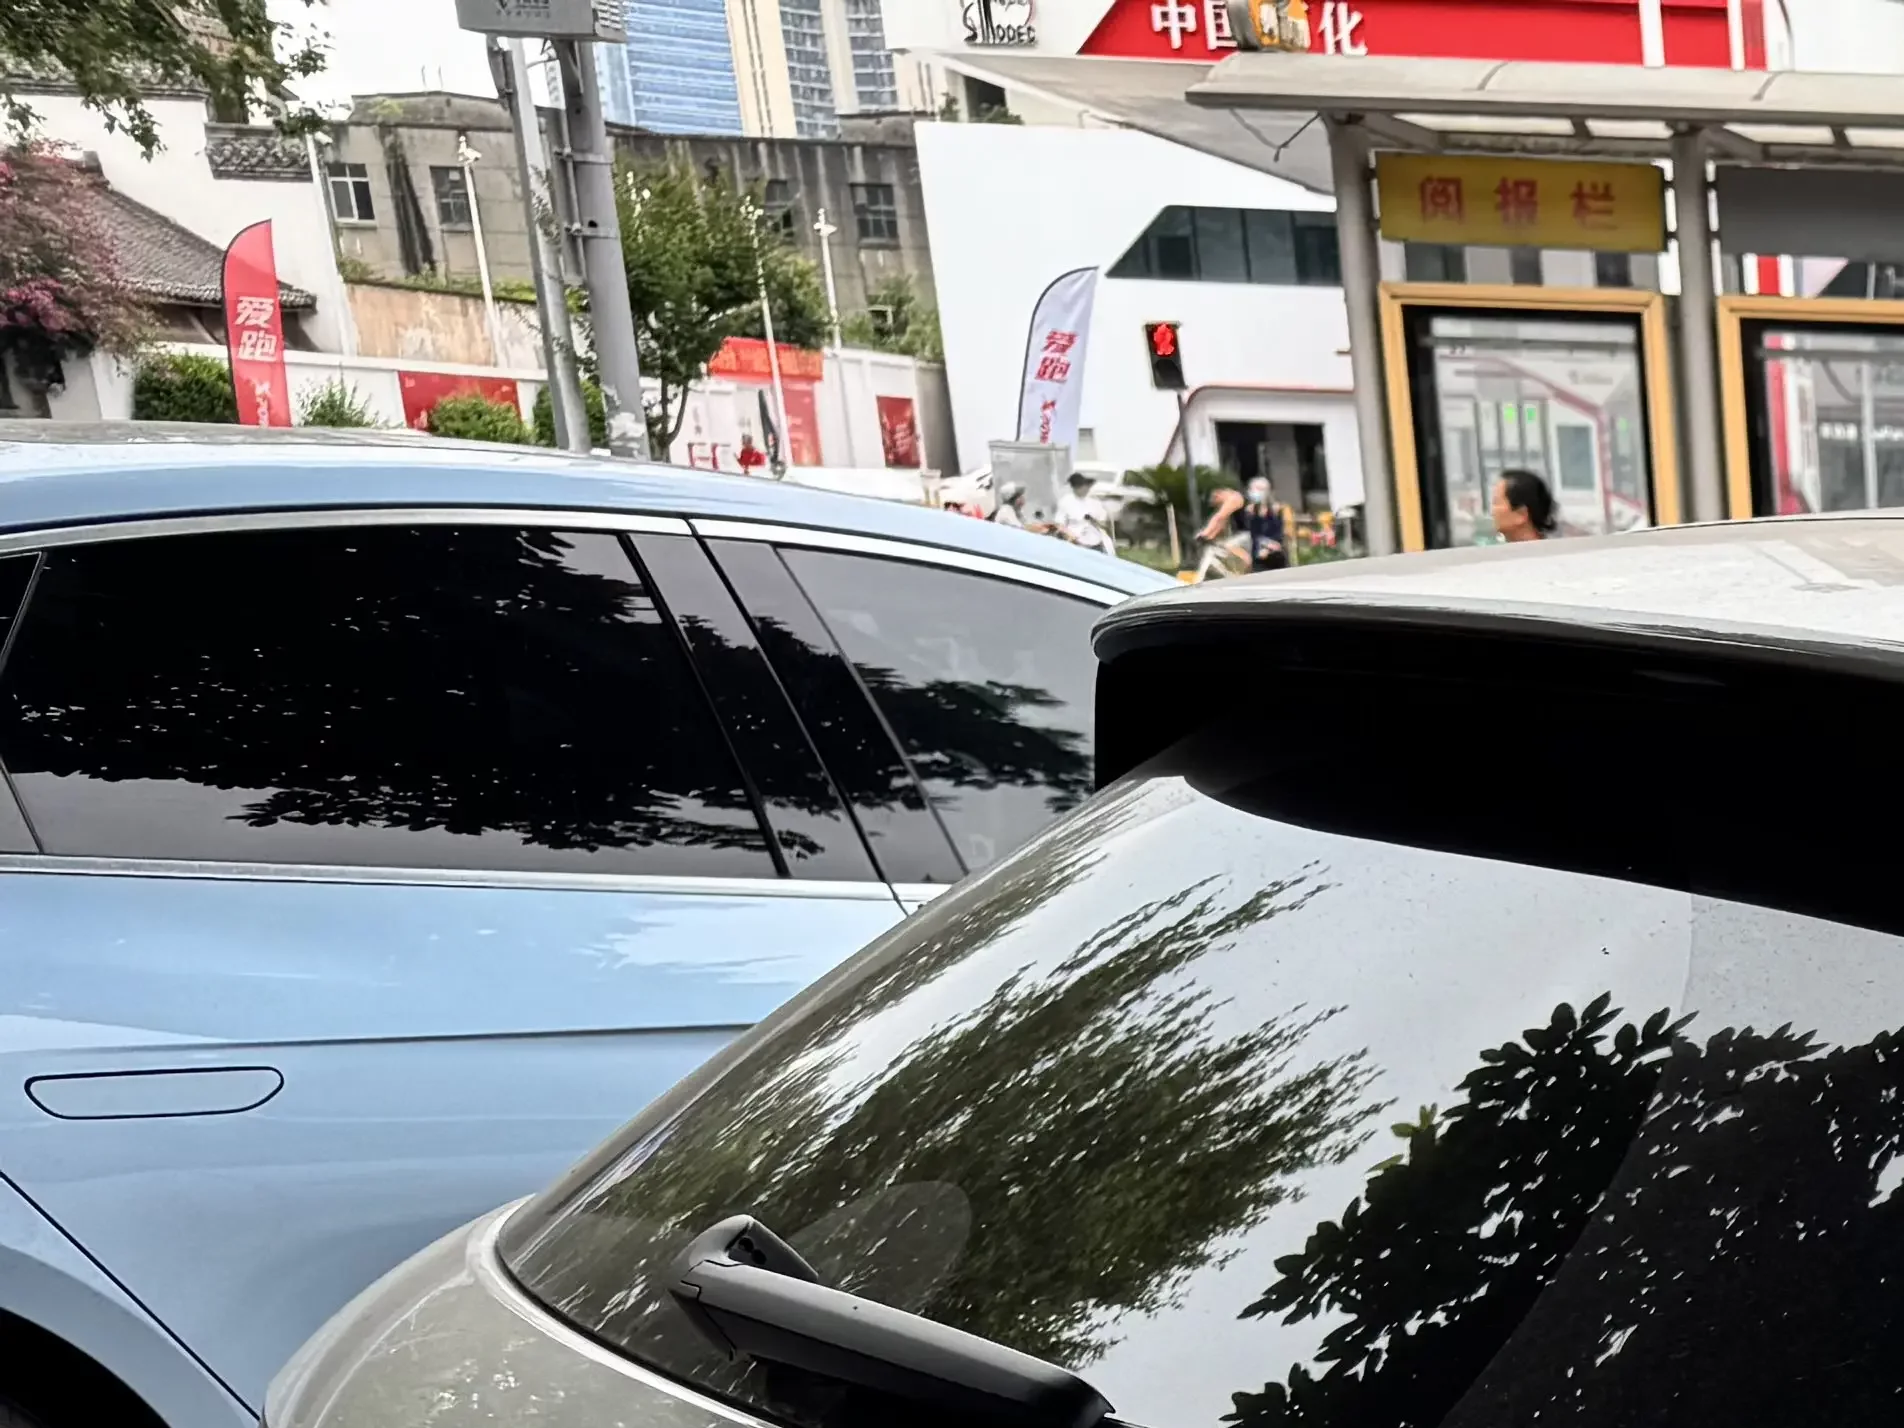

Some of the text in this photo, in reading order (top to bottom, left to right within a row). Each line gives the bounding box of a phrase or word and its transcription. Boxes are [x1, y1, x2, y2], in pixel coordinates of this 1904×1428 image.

[1152, 0, 1368, 56] 中国化
[1420, 176, 1618, 230] 阅报栏
[234, 296, 277, 362] 爱跑
